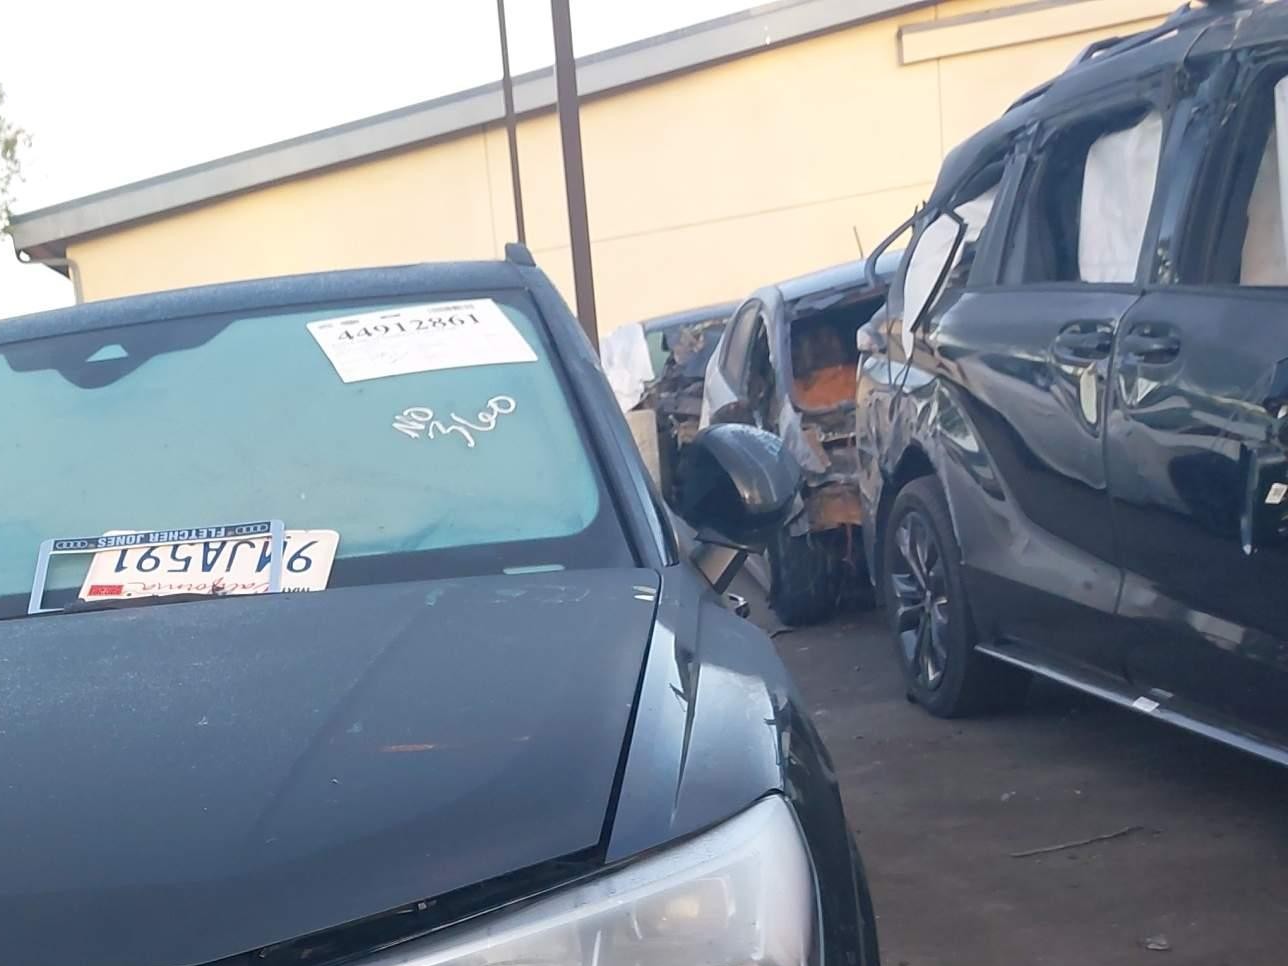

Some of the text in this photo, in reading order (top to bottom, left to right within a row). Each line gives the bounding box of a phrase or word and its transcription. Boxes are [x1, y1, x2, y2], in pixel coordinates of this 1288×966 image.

[337, 312, 481, 342] 44912861
[96, 526, 226, 548] FLETCHER JONES
